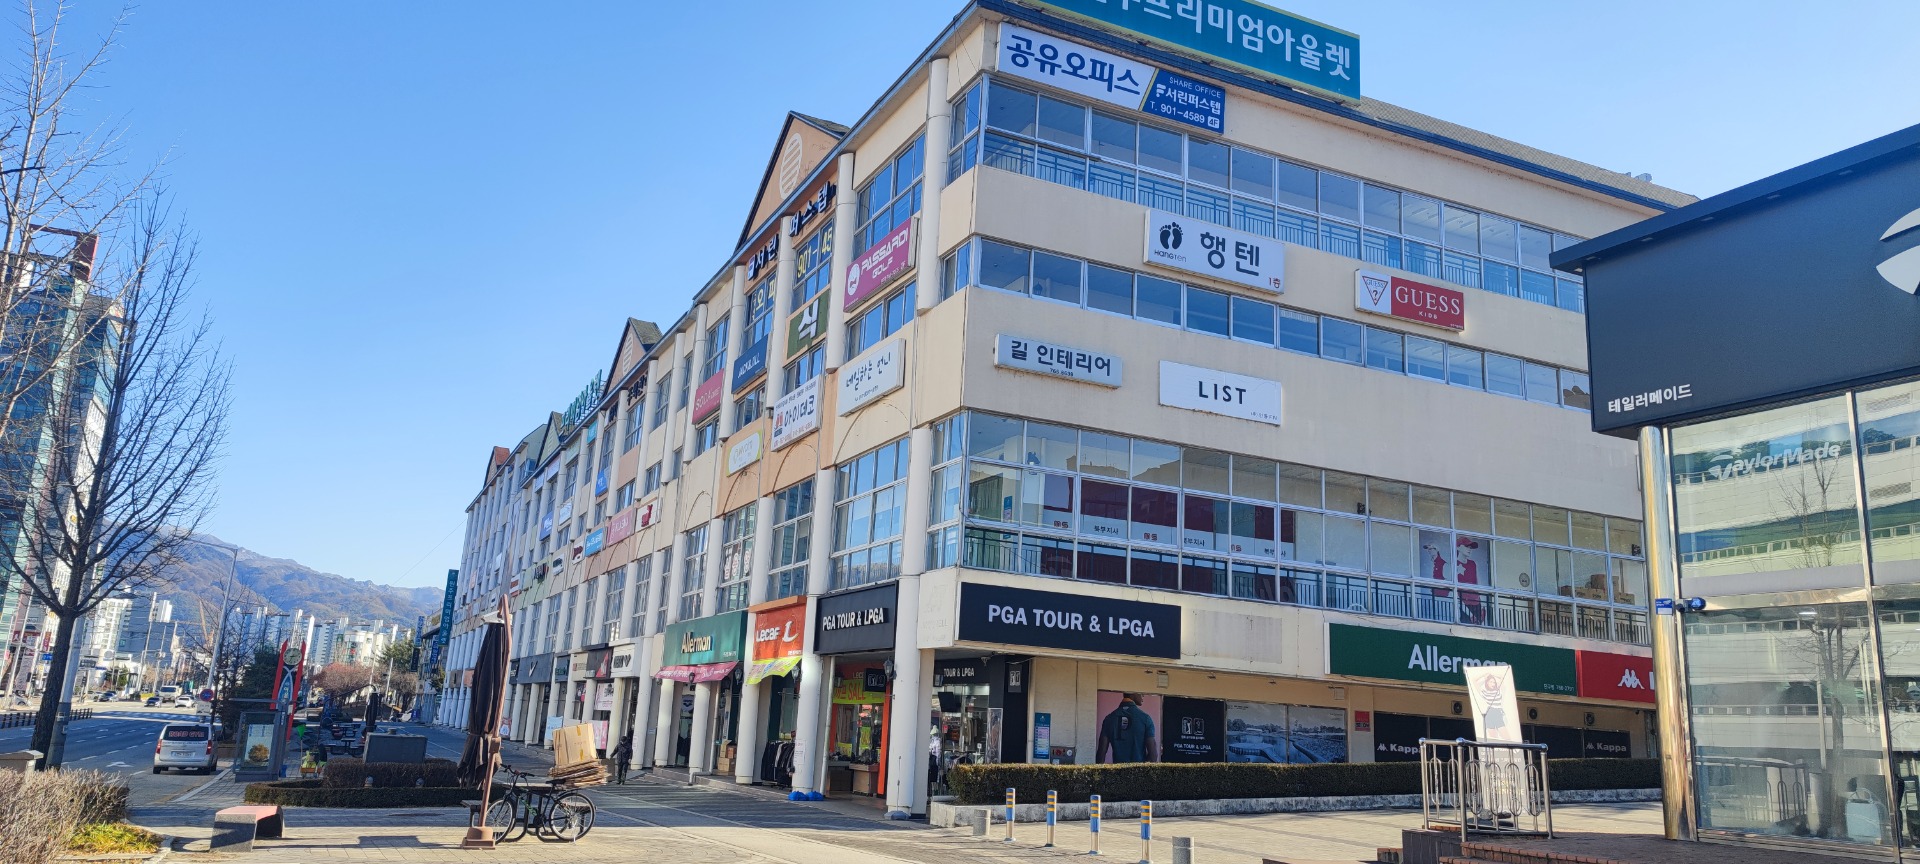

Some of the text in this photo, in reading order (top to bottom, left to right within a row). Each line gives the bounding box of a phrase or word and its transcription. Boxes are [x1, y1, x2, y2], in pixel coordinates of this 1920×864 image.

[1096, 0, 1350, 82] 프리미엄아울렛
[1007, 34, 1141, 97] 공유오피스
[1169, 76, 1222, 99] SHARE OFFICE
[1160, 103, 1206, 124] 901-4589
[1208, 116, 1220, 129] 4F
[1200, 231, 1260, 277] 행텐
[872, 256, 893, 279] GOLF
[1268, 276, 1281, 289] 1층
[1366, 278, 1385, 289] GUESS
[1395, 285, 1461, 316] GUESS
[877, 351, 891, 375] 언니
[1011, 340, 1112, 377] 길 인테리어
[1198, 380, 1246, 405] LIST
[1607, 383, 1693, 413] 테일러메이드
[822, 607, 884, 632] PGA TOUR & LPGA
[988, 604, 1155, 639] PGA TOUR & LPGA
[680, 631, 712, 654] Allerman
[943, 668, 956, 677] TOUR
[961, 667, 975, 677] LPGA
[1596, 742, 1627, 753] Kappa
